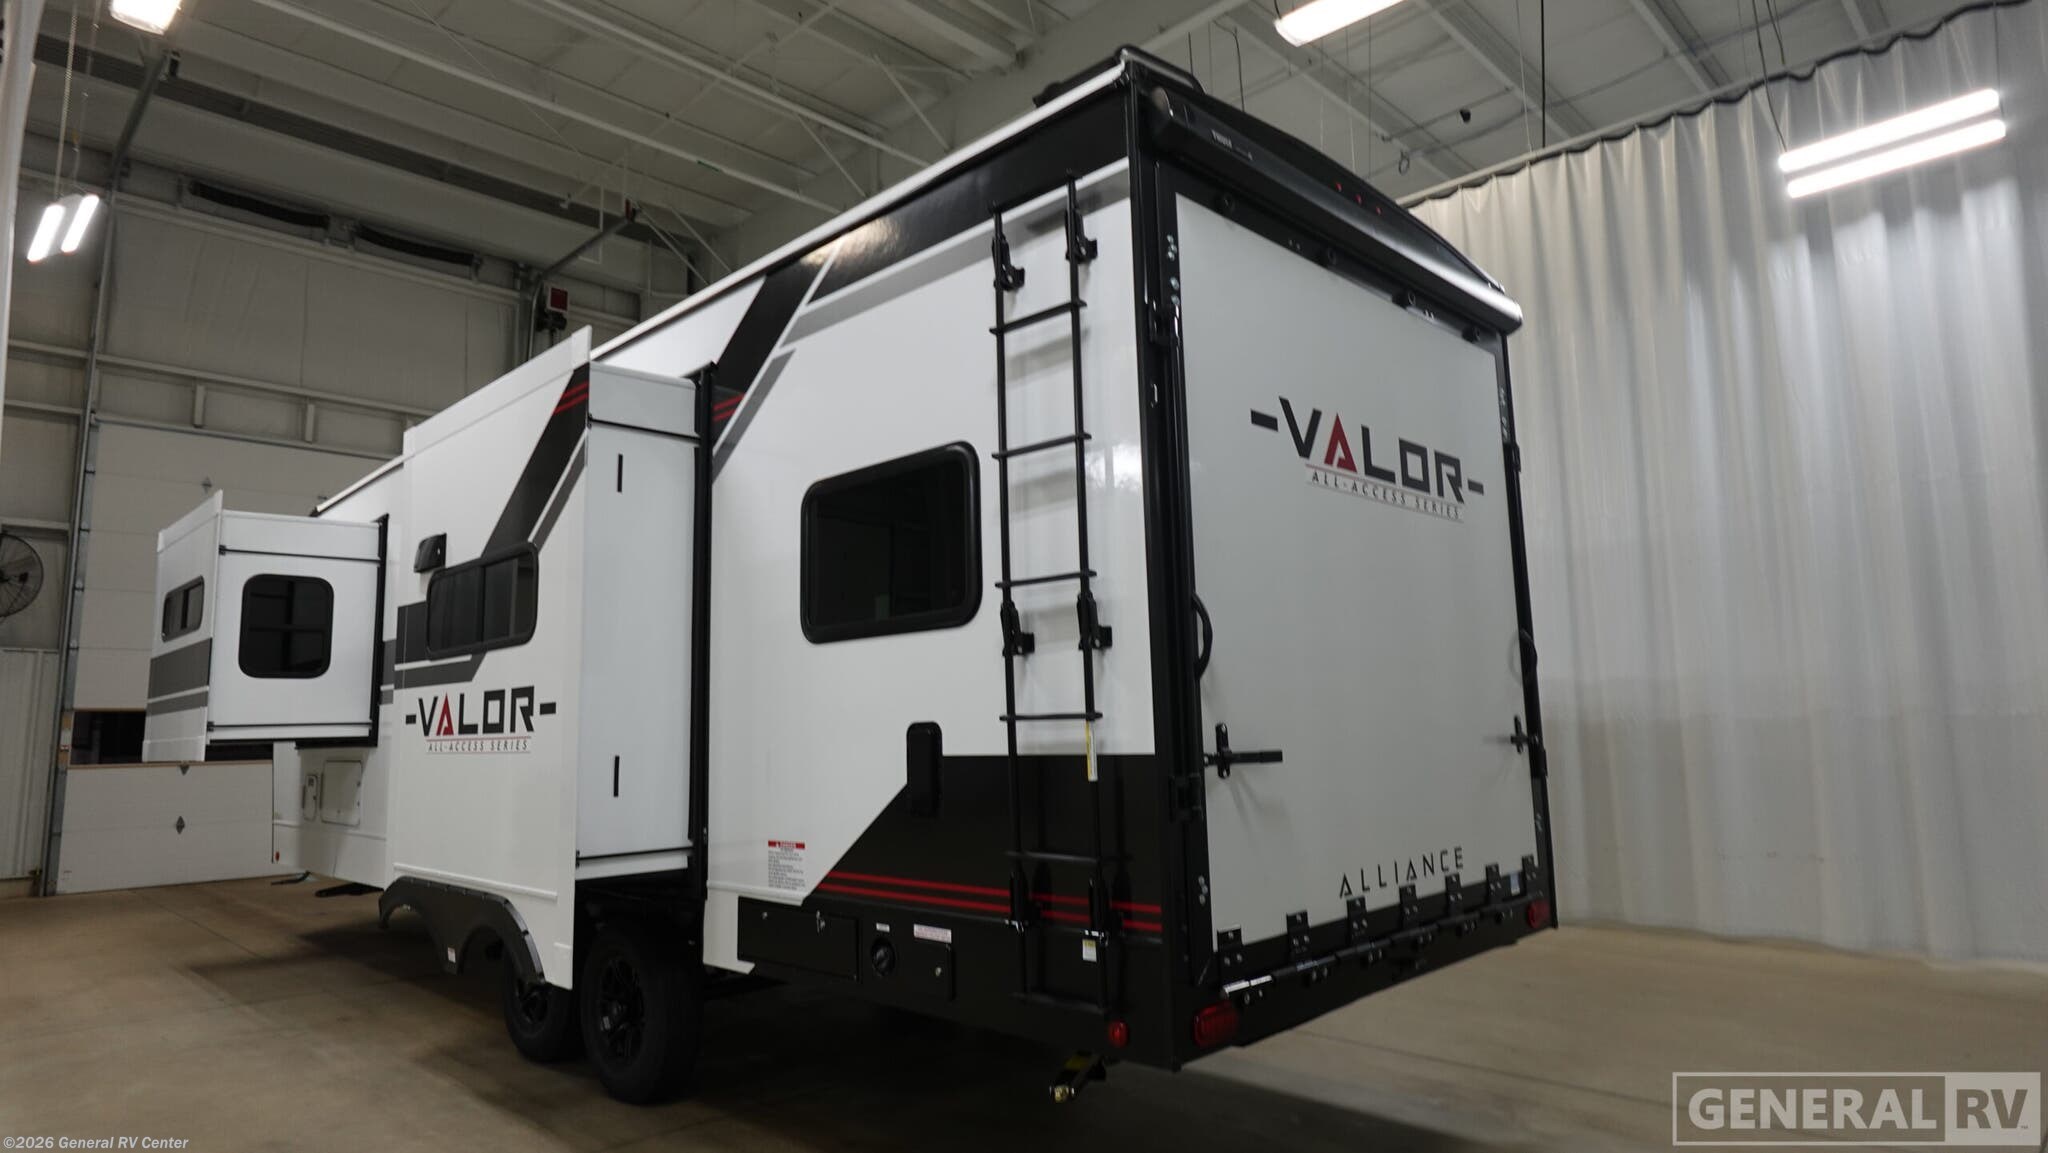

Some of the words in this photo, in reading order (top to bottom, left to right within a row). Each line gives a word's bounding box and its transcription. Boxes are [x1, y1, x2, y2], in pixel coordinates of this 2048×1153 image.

[1311, 469, 1407, 506] ALL-ACCESS
[1415, 498, 1460, 521] SERIES
[428, 740, 485, 753] ALL-ACCESS
[490, 739, 528, 752] SERIES
[1339, 846, 1464, 899] ALLIANCE
